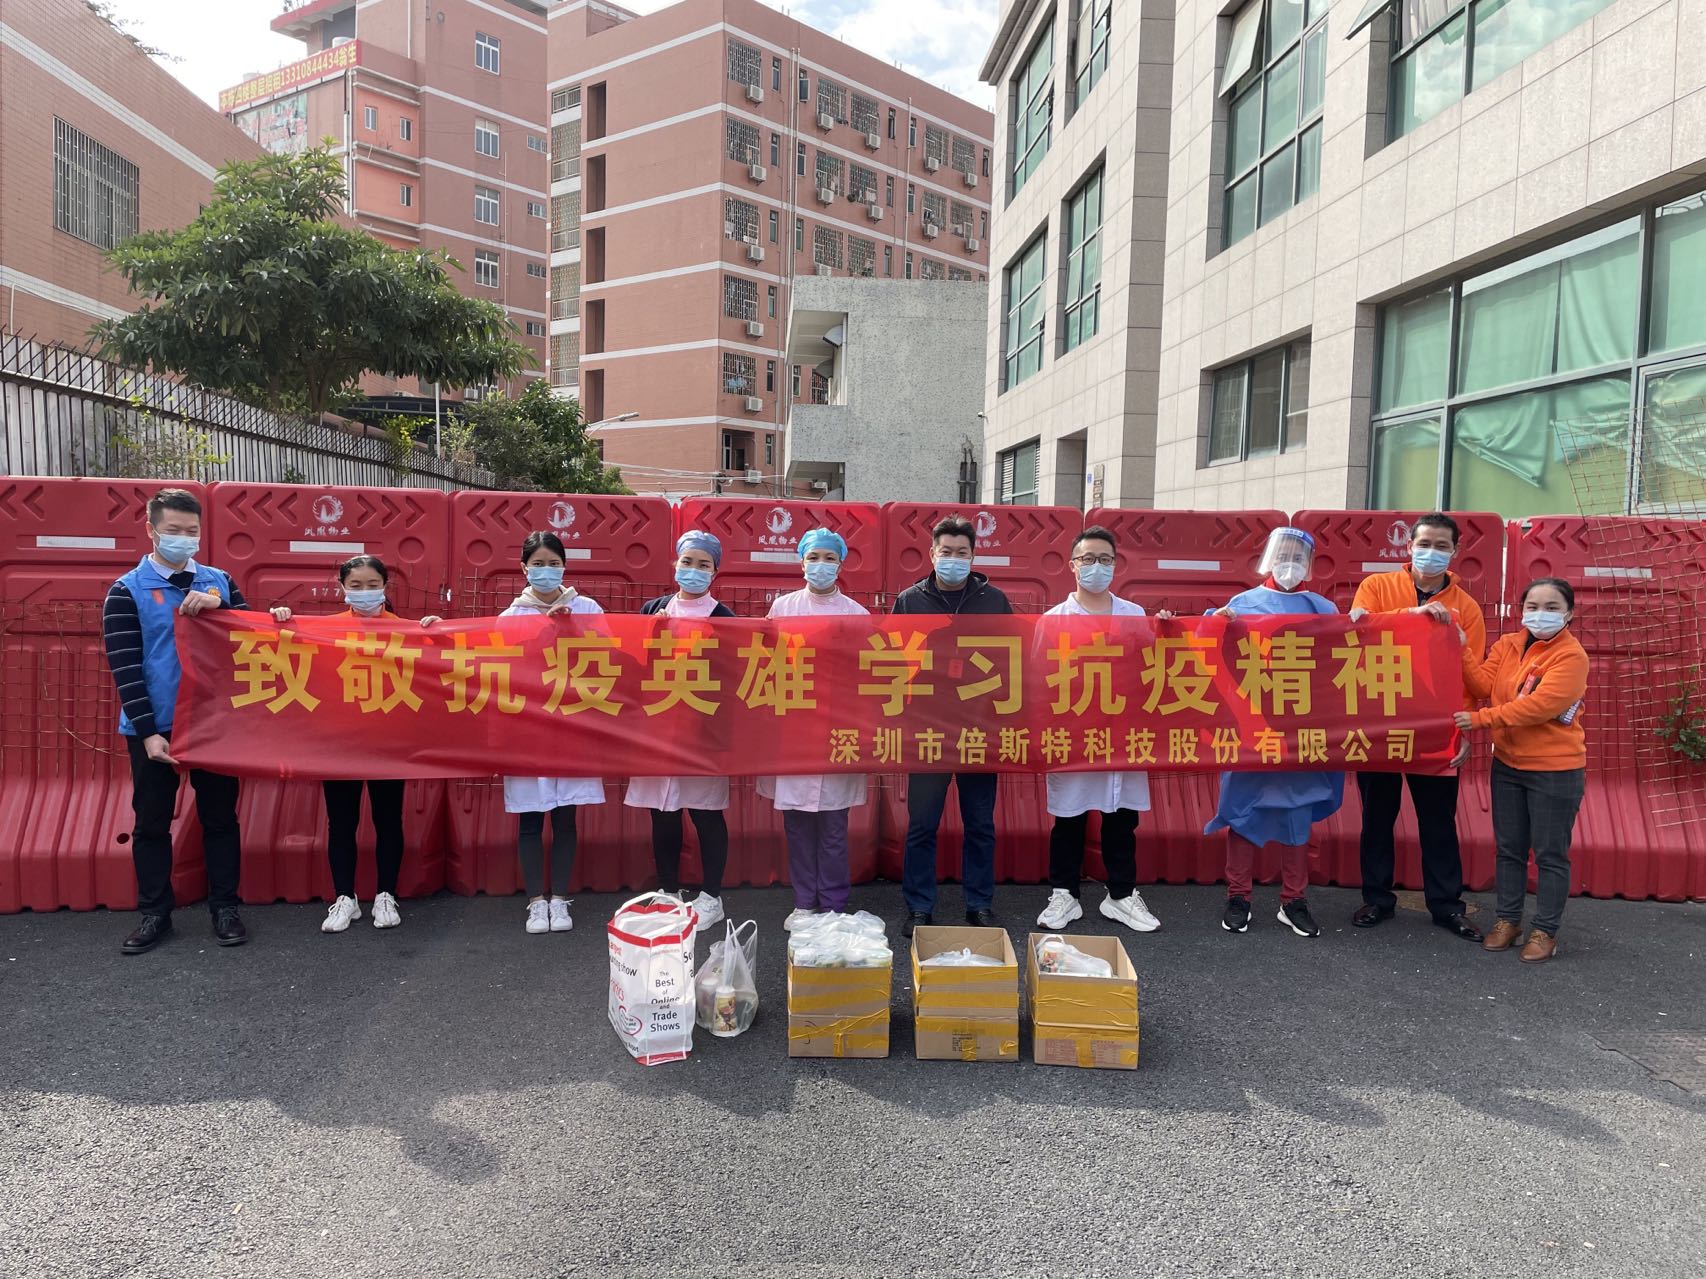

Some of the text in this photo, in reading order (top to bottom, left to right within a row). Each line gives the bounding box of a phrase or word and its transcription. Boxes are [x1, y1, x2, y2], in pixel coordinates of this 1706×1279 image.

[231, 631, 1413, 717] 致敬抗疫英雄 学习抗疫精神
[828, 727, 1415, 765] 深圳市倍斯特科技股份有限公司
[655, 977, 675, 987] Best
[652, 1010, 678, 1021] Trade
[650, 1022, 680, 1033] Shows
